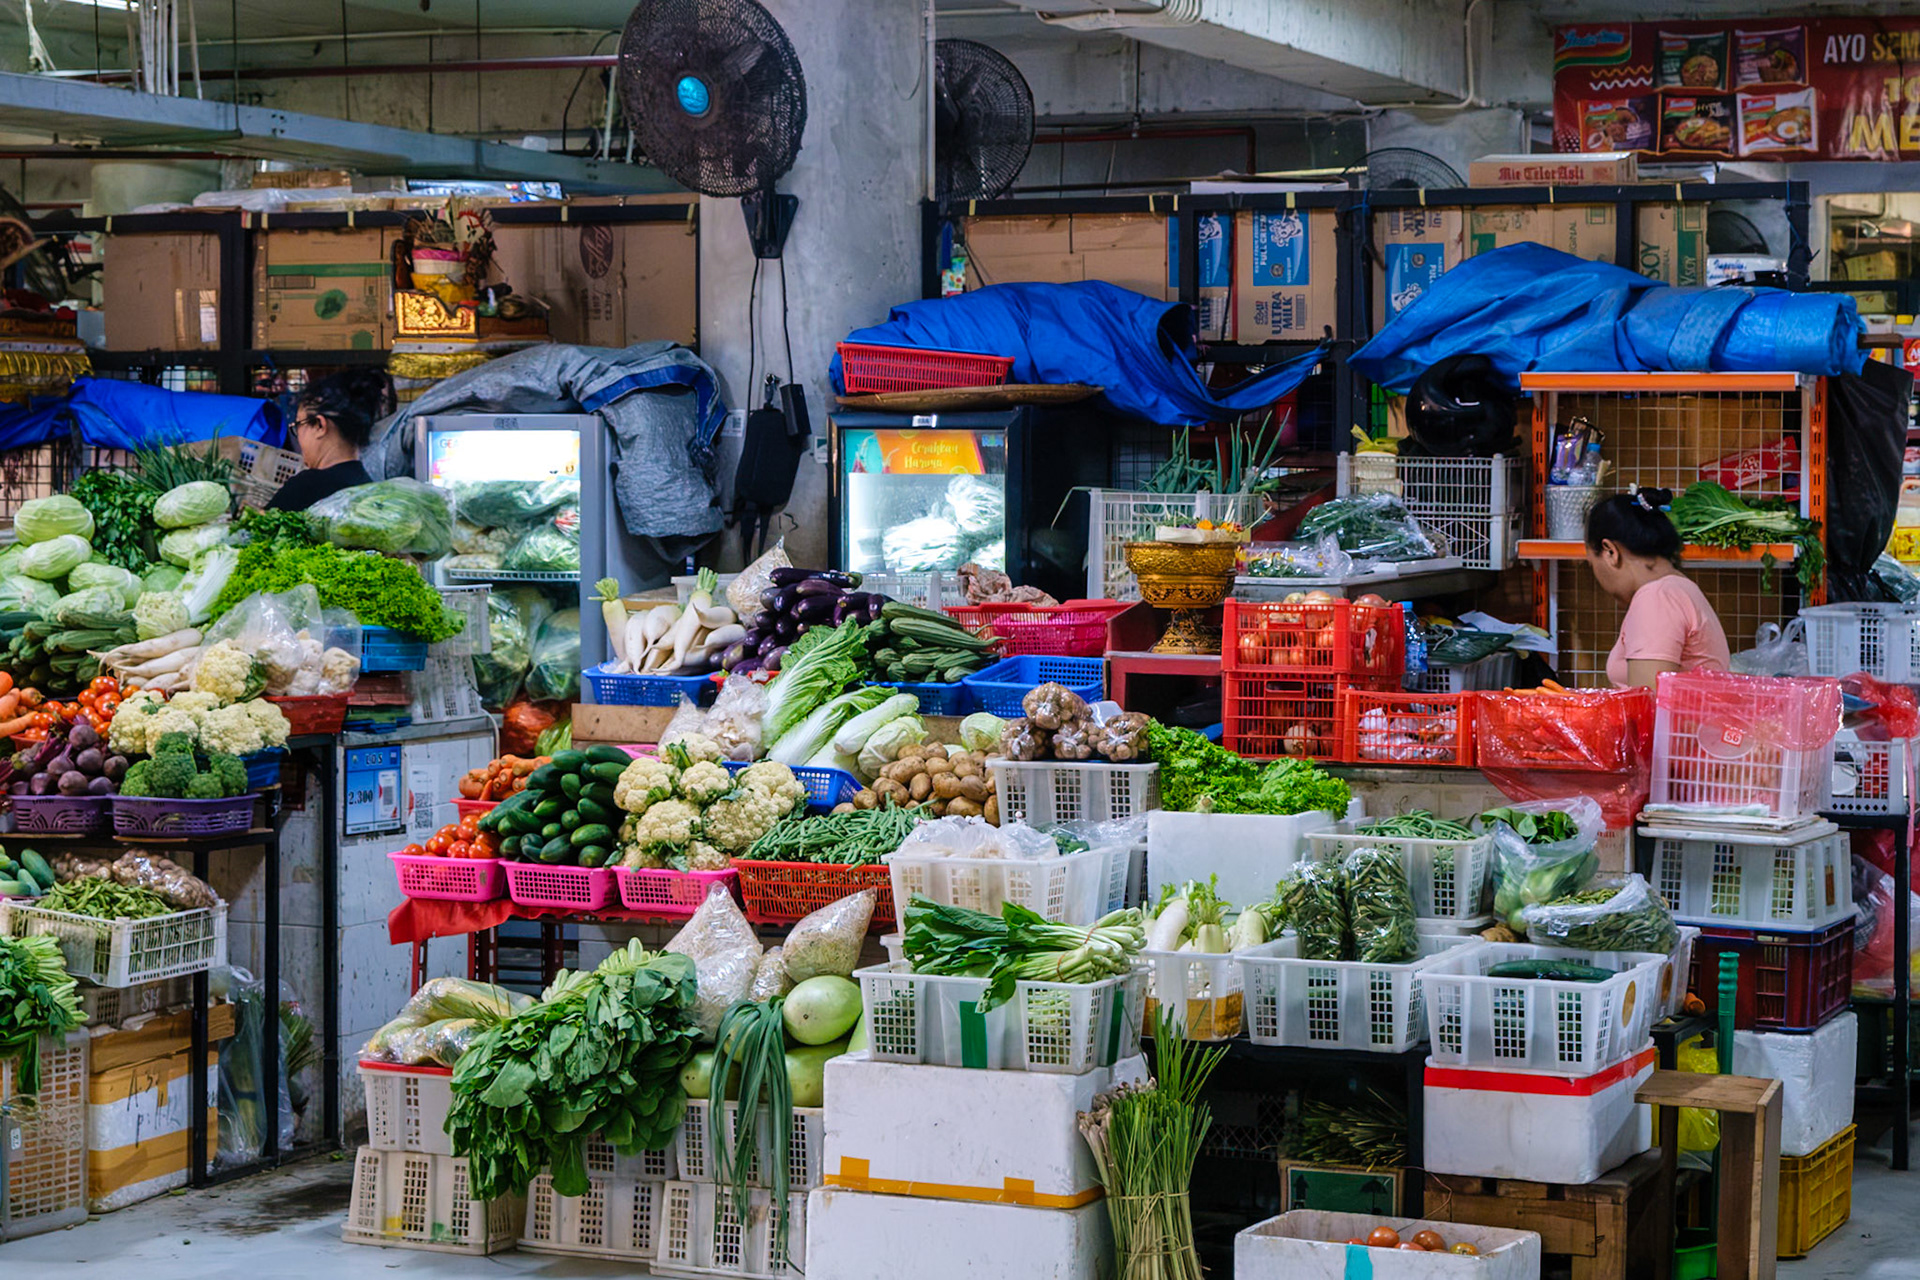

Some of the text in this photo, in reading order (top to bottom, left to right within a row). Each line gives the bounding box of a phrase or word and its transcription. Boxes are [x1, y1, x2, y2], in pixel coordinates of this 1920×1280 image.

[1823, 33, 1866, 63] AYO
[1259, 244, 1268, 266] FULL
[1640, 240, 1661, 280] SOY
[1271, 292, 1283, 335] ULTRA
[1282, 297, 1293, 330] MILK
[1726, 732, 1740, 743] 56
[348, 789, 374, 805] 2.300
